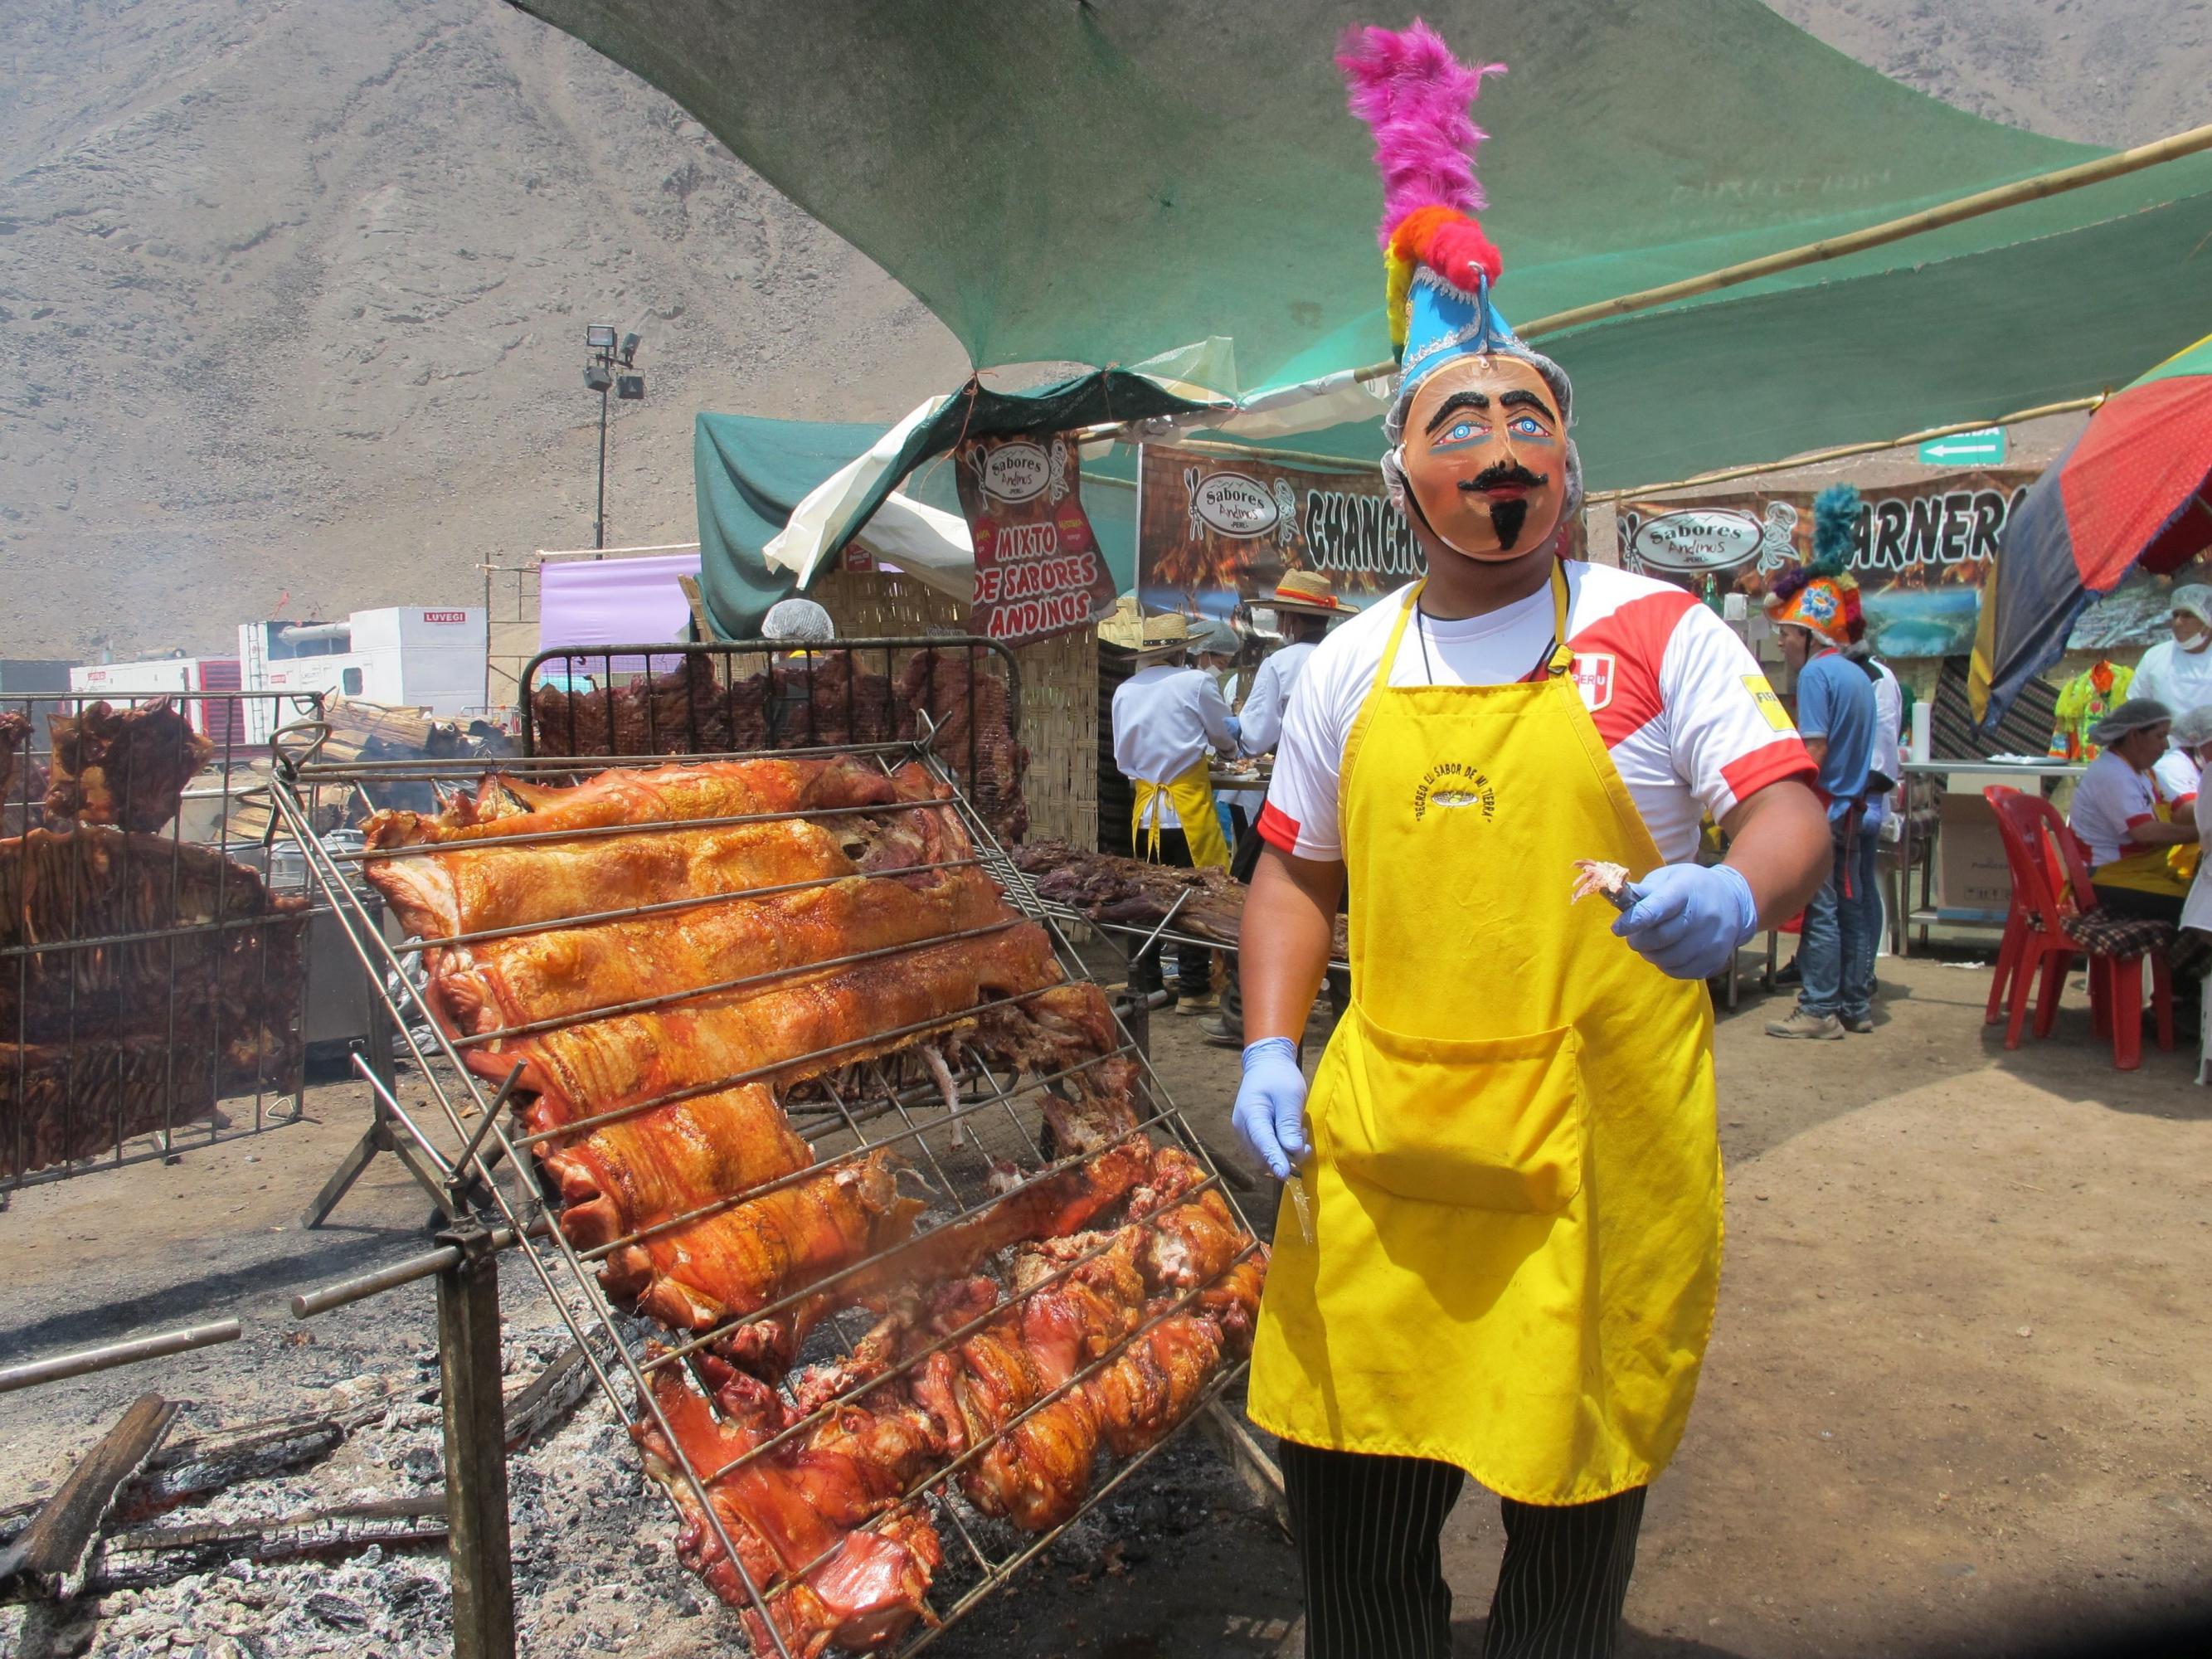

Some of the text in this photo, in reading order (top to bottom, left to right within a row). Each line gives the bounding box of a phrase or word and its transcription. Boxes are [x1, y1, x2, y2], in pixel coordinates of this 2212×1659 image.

[991, 457, 1041, 476] Sabores
[1206, 487, 1265, 509] Sabores
[1650, 524, 1742, 545] Sabores
[1845, 484, 2030, 572] ARNER
[995, 522, 1057, 562] MIXTO
[1004, 552, 1098, 601] SABORES
[425, 613, 463, 621] LUVEGI
[987, 590, 1091, 640] ANDINOS
[1572, 674, 1606, 686] PERU
[1433, 763, 1461, 777] SABOR
[1464, 766, 1477, 780] DE
[1475, 775, 1488, 787] MI
[1415, 784, 1428, 818] RECREO
[1481, 788, 1495, 817] TIERRA
